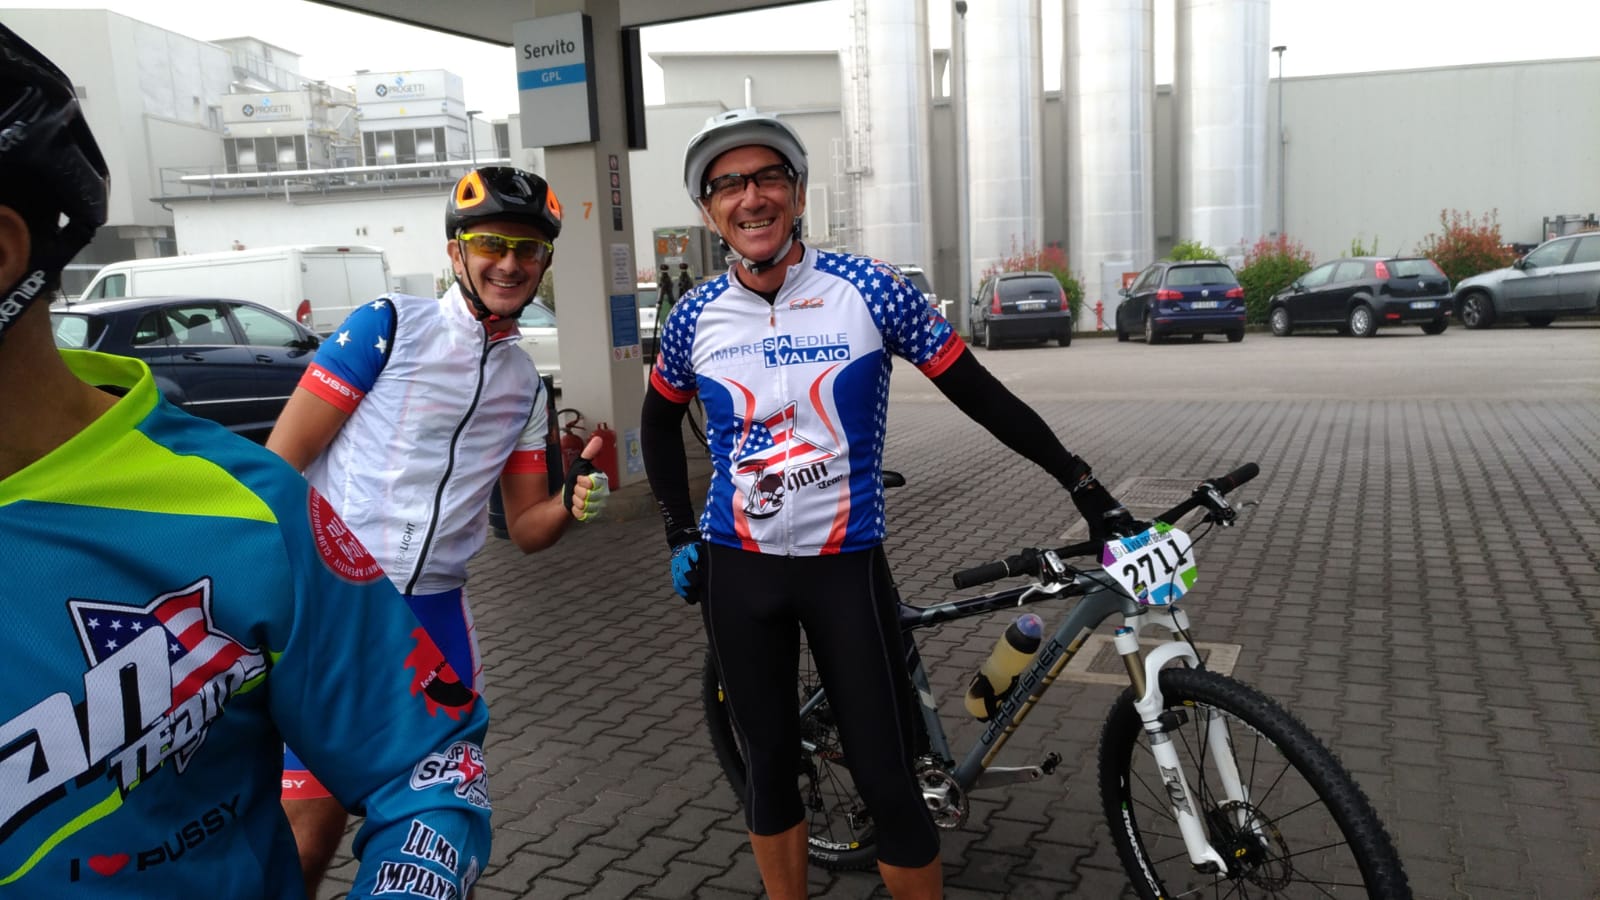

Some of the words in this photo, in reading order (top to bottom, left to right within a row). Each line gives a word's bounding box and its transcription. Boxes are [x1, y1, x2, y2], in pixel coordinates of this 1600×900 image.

[523, 38, 576, 60] Servito
[388, 83, 426, 93] PROGETTI
[541, 71, 562, 83] GPL
[254, 105, 292, 113] PROGETTI
[582, 201, 593, 220] 7
[795, 332, 849, 348] EDILE
[311, 369, 361, 400] PUSSY
[318, 534, 333, 557] CLUB
[1122, 539, 1188, 593] 2711
[1011, 639, 1063, 704] FISHER
[1160, 765, 1194, 817] FOX
[70, 858, 80, 882] I
[137, 793, 241, 872] PUSSY
